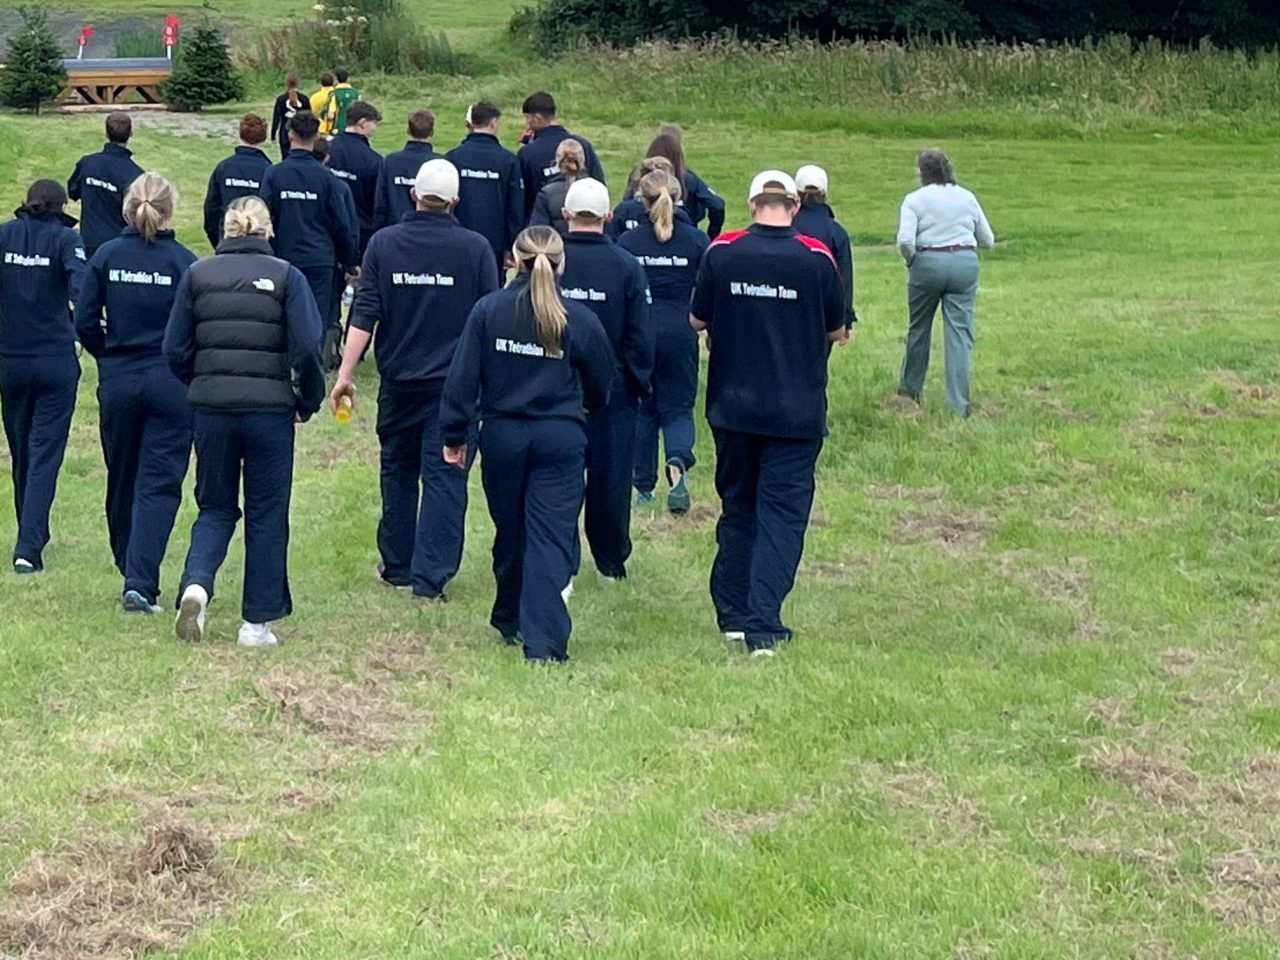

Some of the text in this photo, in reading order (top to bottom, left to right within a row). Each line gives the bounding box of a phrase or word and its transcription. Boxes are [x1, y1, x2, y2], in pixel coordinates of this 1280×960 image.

[109, 269, 171, 285] UK Tetrathlon Team
[393, 273, 454, 286] UK Tetrathlon Team
[588, 288, 606, 301] Team
[730, 282, 798, 300] UK Tetrathlon Team
[495, 338, 507, 352] UK
[508, 339, 544, 357] Tetrathlon
